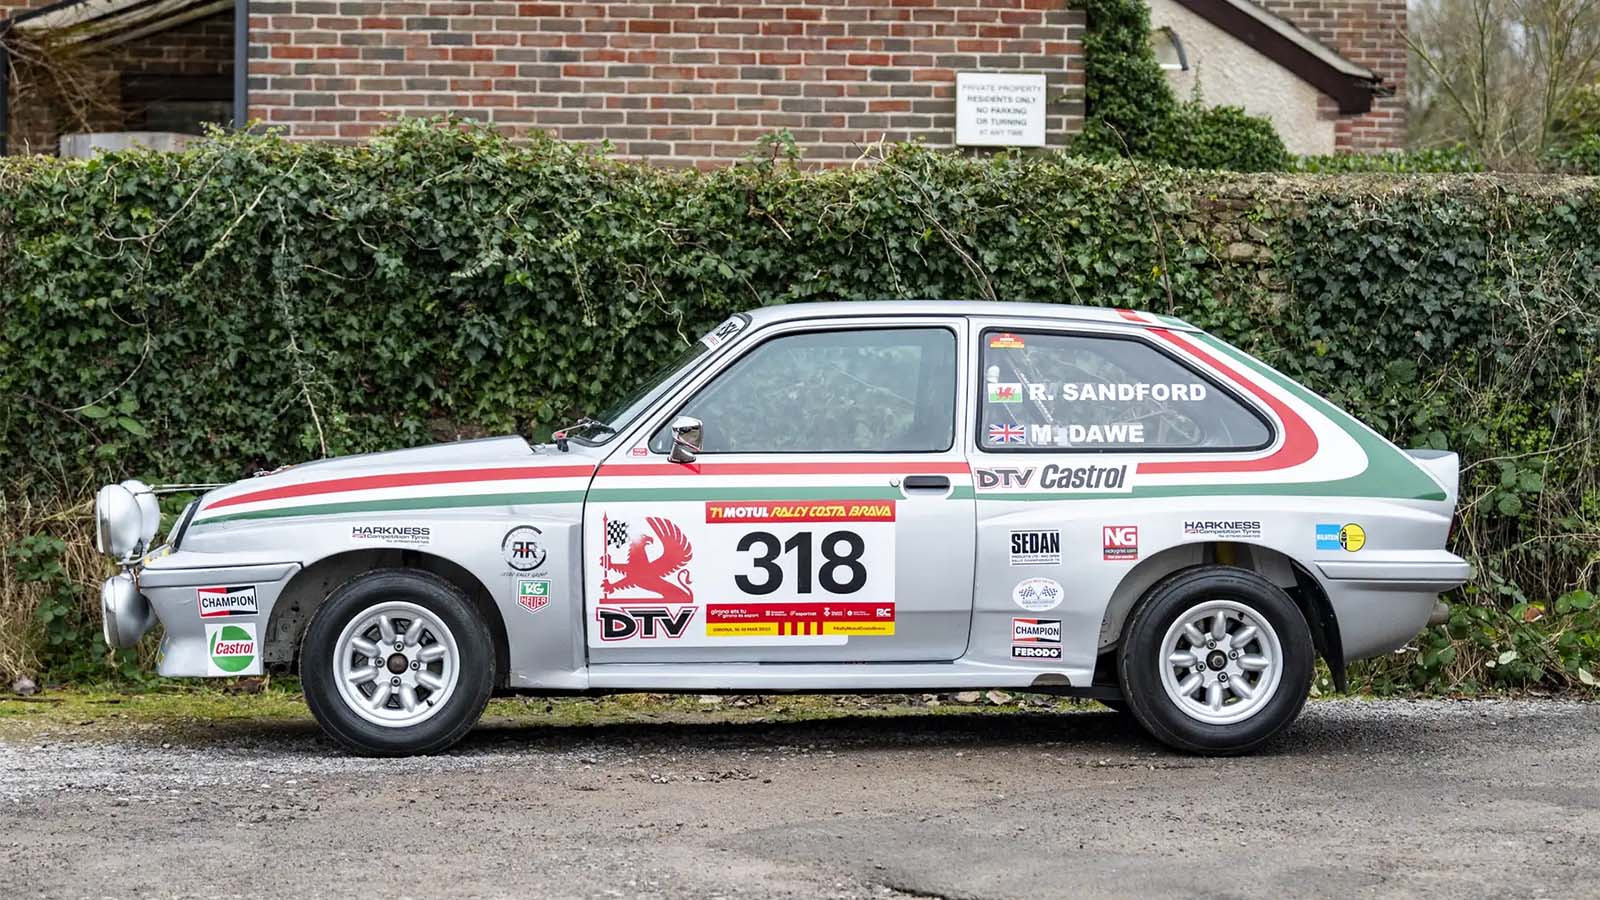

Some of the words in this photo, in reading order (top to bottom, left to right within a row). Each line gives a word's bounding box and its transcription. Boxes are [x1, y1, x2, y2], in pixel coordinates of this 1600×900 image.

[991, 118, 1027, 126] TURNING
[1029, 383, 1054, 401] R.
[1063, 382, 1207, 402] SANDFORD
[1031, 424, 1058, 443] M.
[1069, 424, 1145, 443] DAWE
[976, 467, 1034, 489] DTV
[1040, 463, 1128, 489] Castrol
[724, 506, 769, 518] MOTUL
[770, 506, 808, 517] RALLY
[809, 506, 846, 517] COSTA
[849, 505, 892, 517] BRAVA
[352, 526, 431, 536] HARKNESS
[1184, 521, 1261, 530] HARKNESS
[1011, 532, 1060, 554] SEDAN
[1104, 527, 1137, 546] NG
[734, 530, 867, 596] 318
[202, 596, 254, 608] CHAMPION
[520, 596, 548, 609] HEUER
[599, 608, 694, 639] DTV
[1016, 626, 1059, 636] CHAMPION
[216, 642, 254, 654] Castrol
[1014, 648, 1058, 657] FERODO
